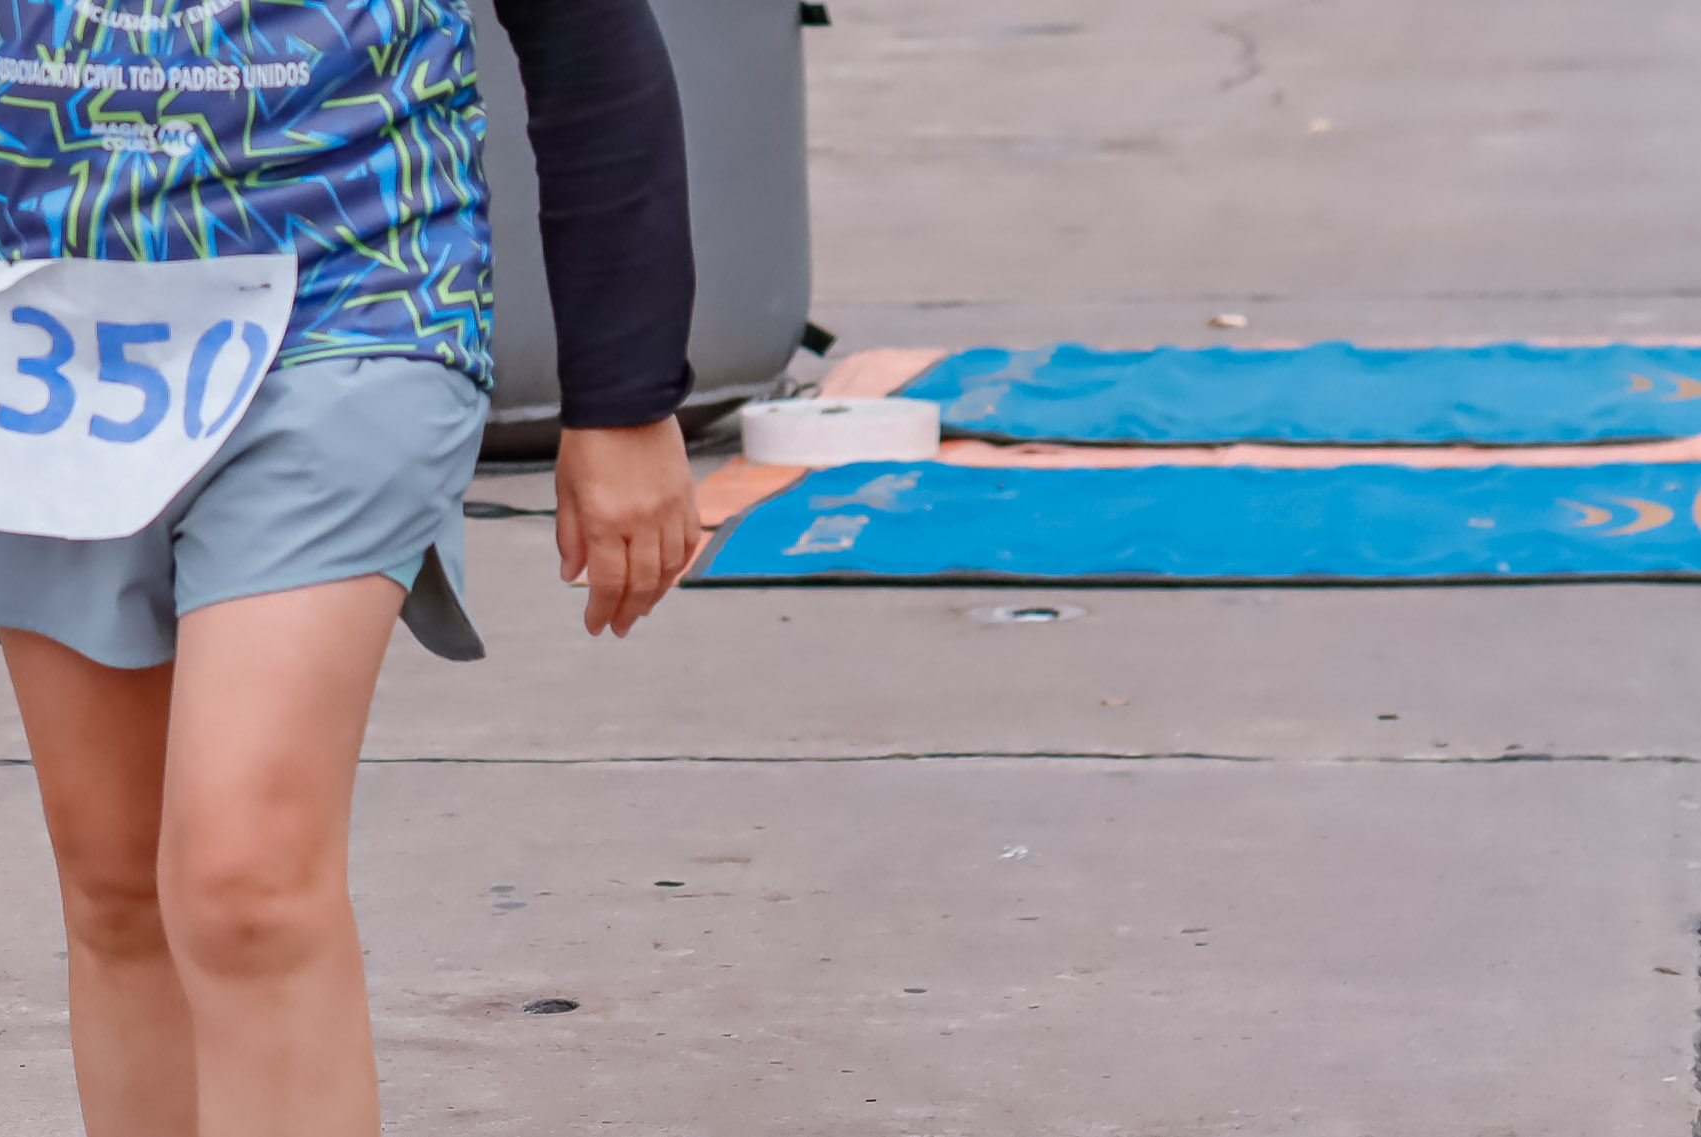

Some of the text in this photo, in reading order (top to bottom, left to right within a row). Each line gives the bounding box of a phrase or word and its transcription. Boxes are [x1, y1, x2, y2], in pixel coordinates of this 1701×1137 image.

[82, 64, 128, 91] CIVIL
[129, 66, 166, 92] TGD
[167, 66, 241, 92] PADRES
[242, 61, 311, 90] UNIDOS
